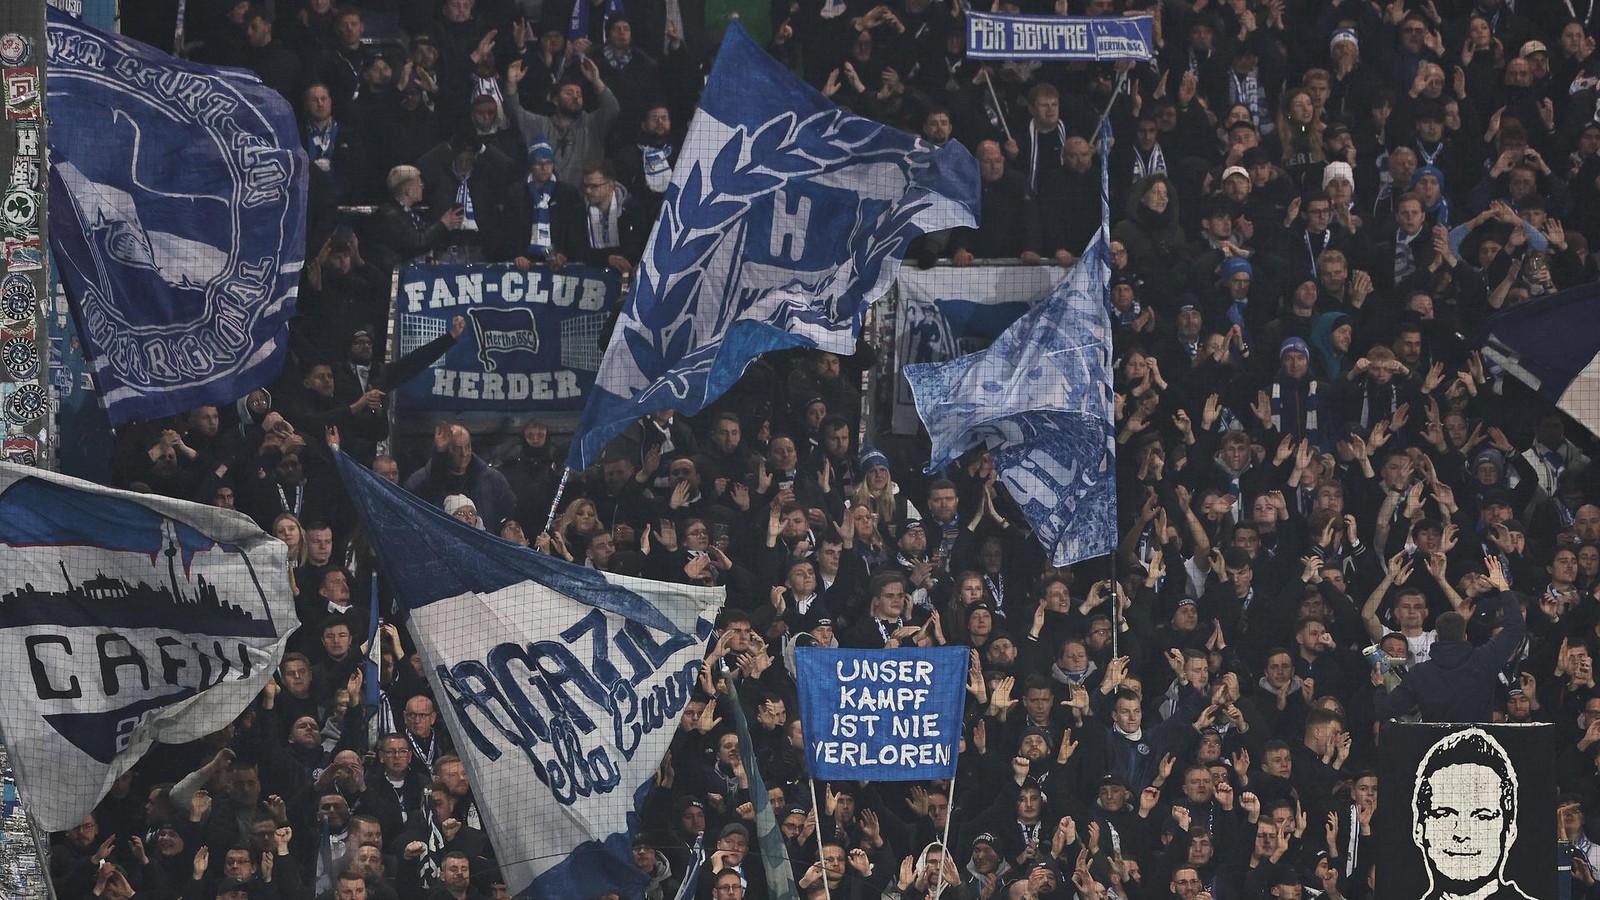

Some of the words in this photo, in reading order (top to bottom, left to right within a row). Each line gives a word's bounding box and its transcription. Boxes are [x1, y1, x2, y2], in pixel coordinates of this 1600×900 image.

[970, 18, 1006, 50] PER
[1012, 22, 1088, 51] SEMPRE
[770, 189, 812, 262] H
[404, 271, 607, 312] FAN-CLUB
[432, 369, 582, 400] HERDER
[836, 659, 934, 686] UNSER
[839, 686, 930, 712] KAMPF
[831, 713, 881, 738] IST
[892, 713, 941, 739] NIE
